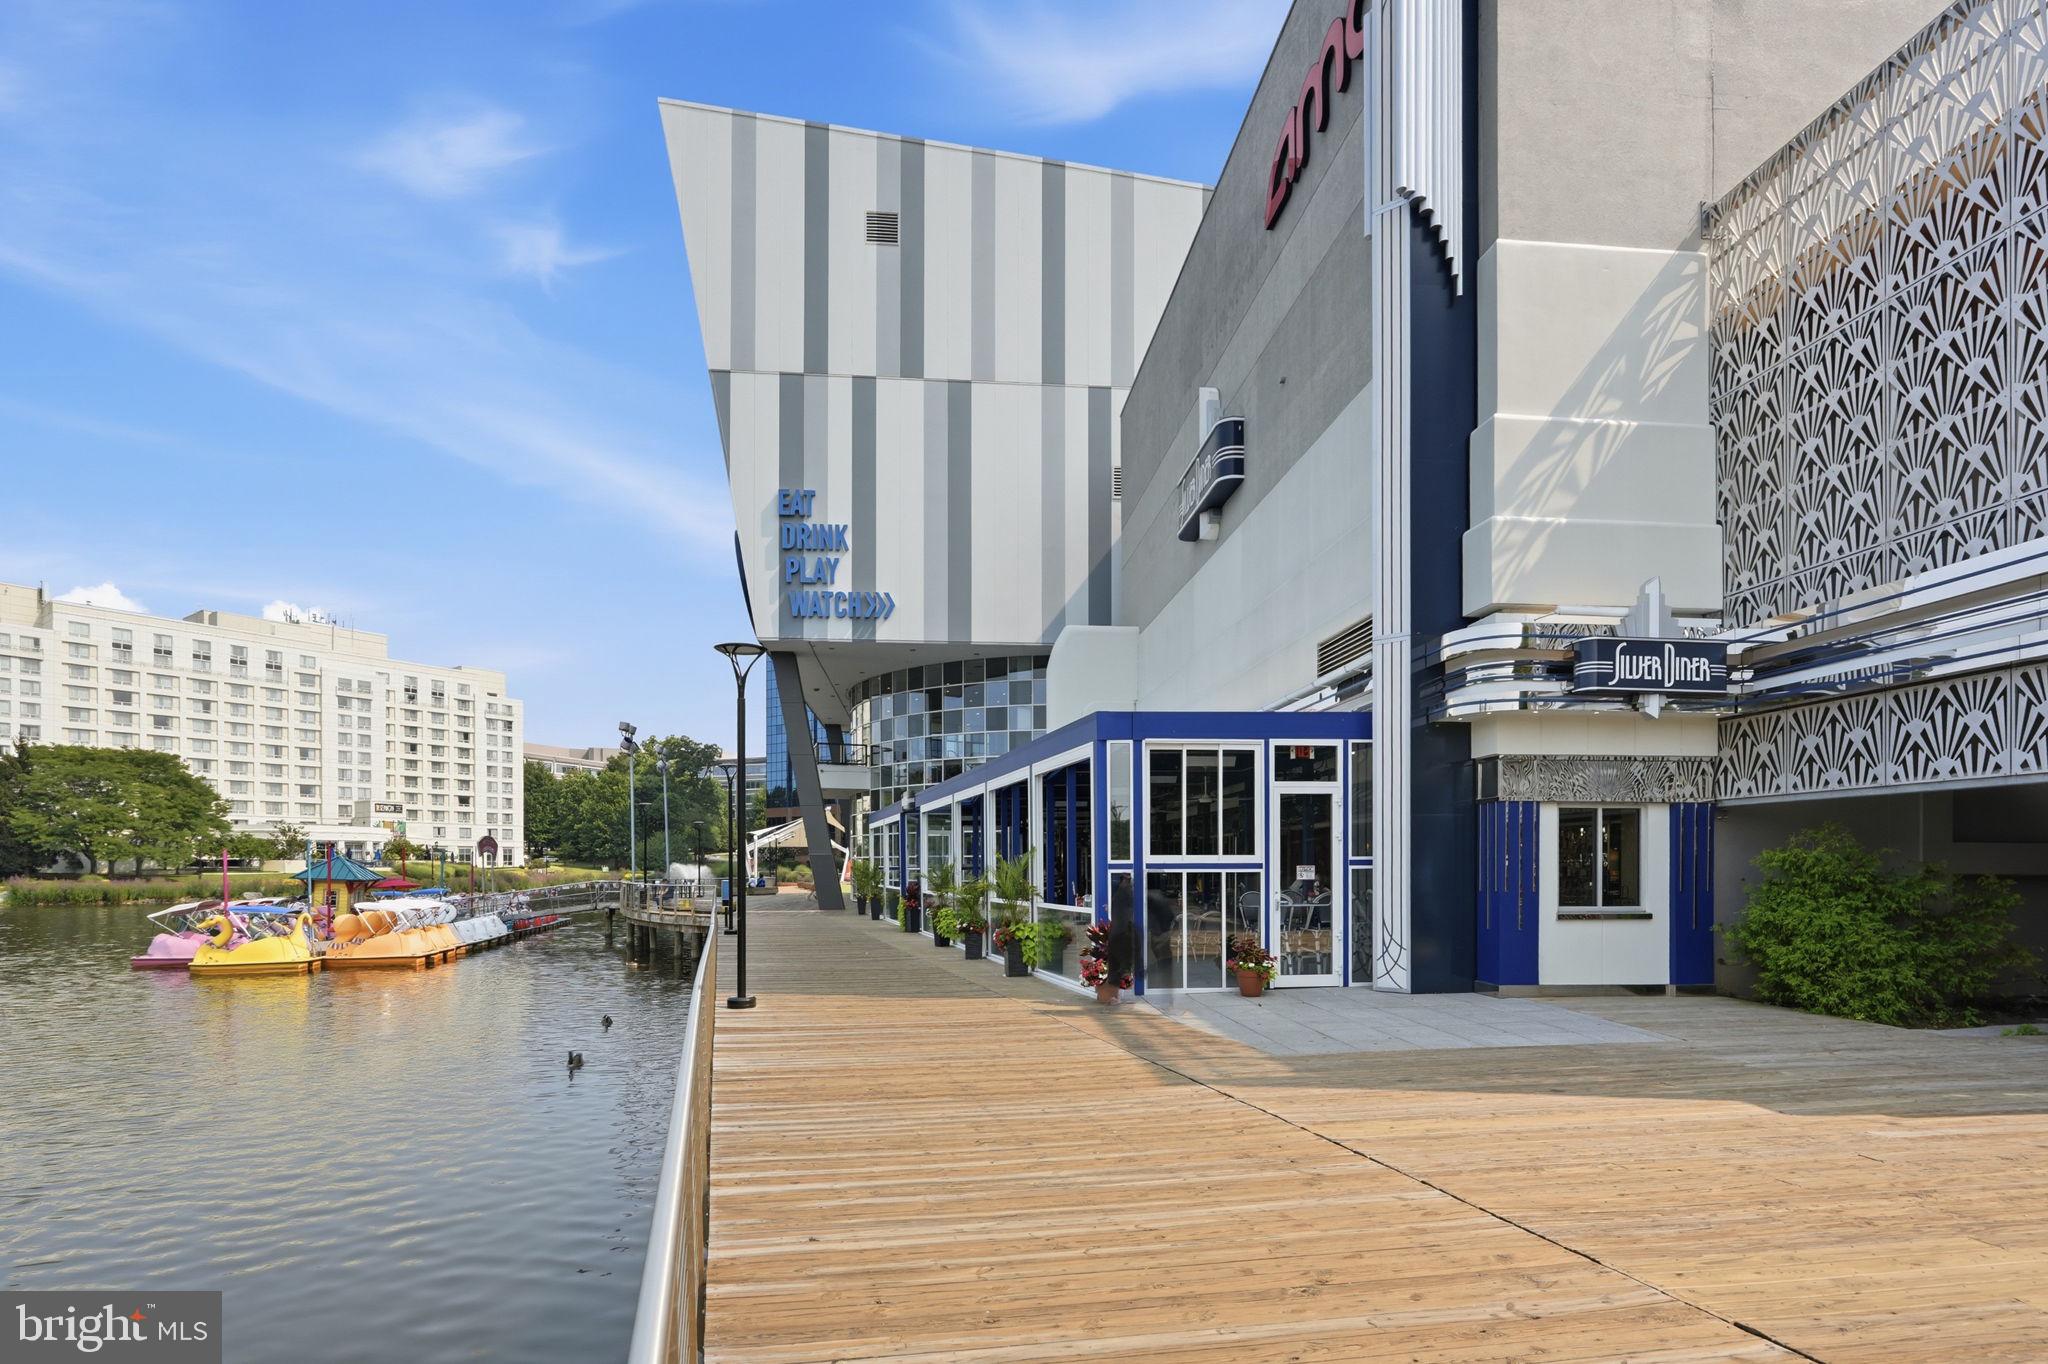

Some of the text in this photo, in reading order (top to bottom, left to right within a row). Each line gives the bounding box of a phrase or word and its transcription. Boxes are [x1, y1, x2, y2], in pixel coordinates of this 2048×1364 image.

[778, 488, 816, 517] EAT
[782, 522, 849, 552] DRINK
[785, 556, 840, 584] PLAY
[788, 591, 862, 619] WATCH
[1608, 642, 1711, 688] SILVER DINER
